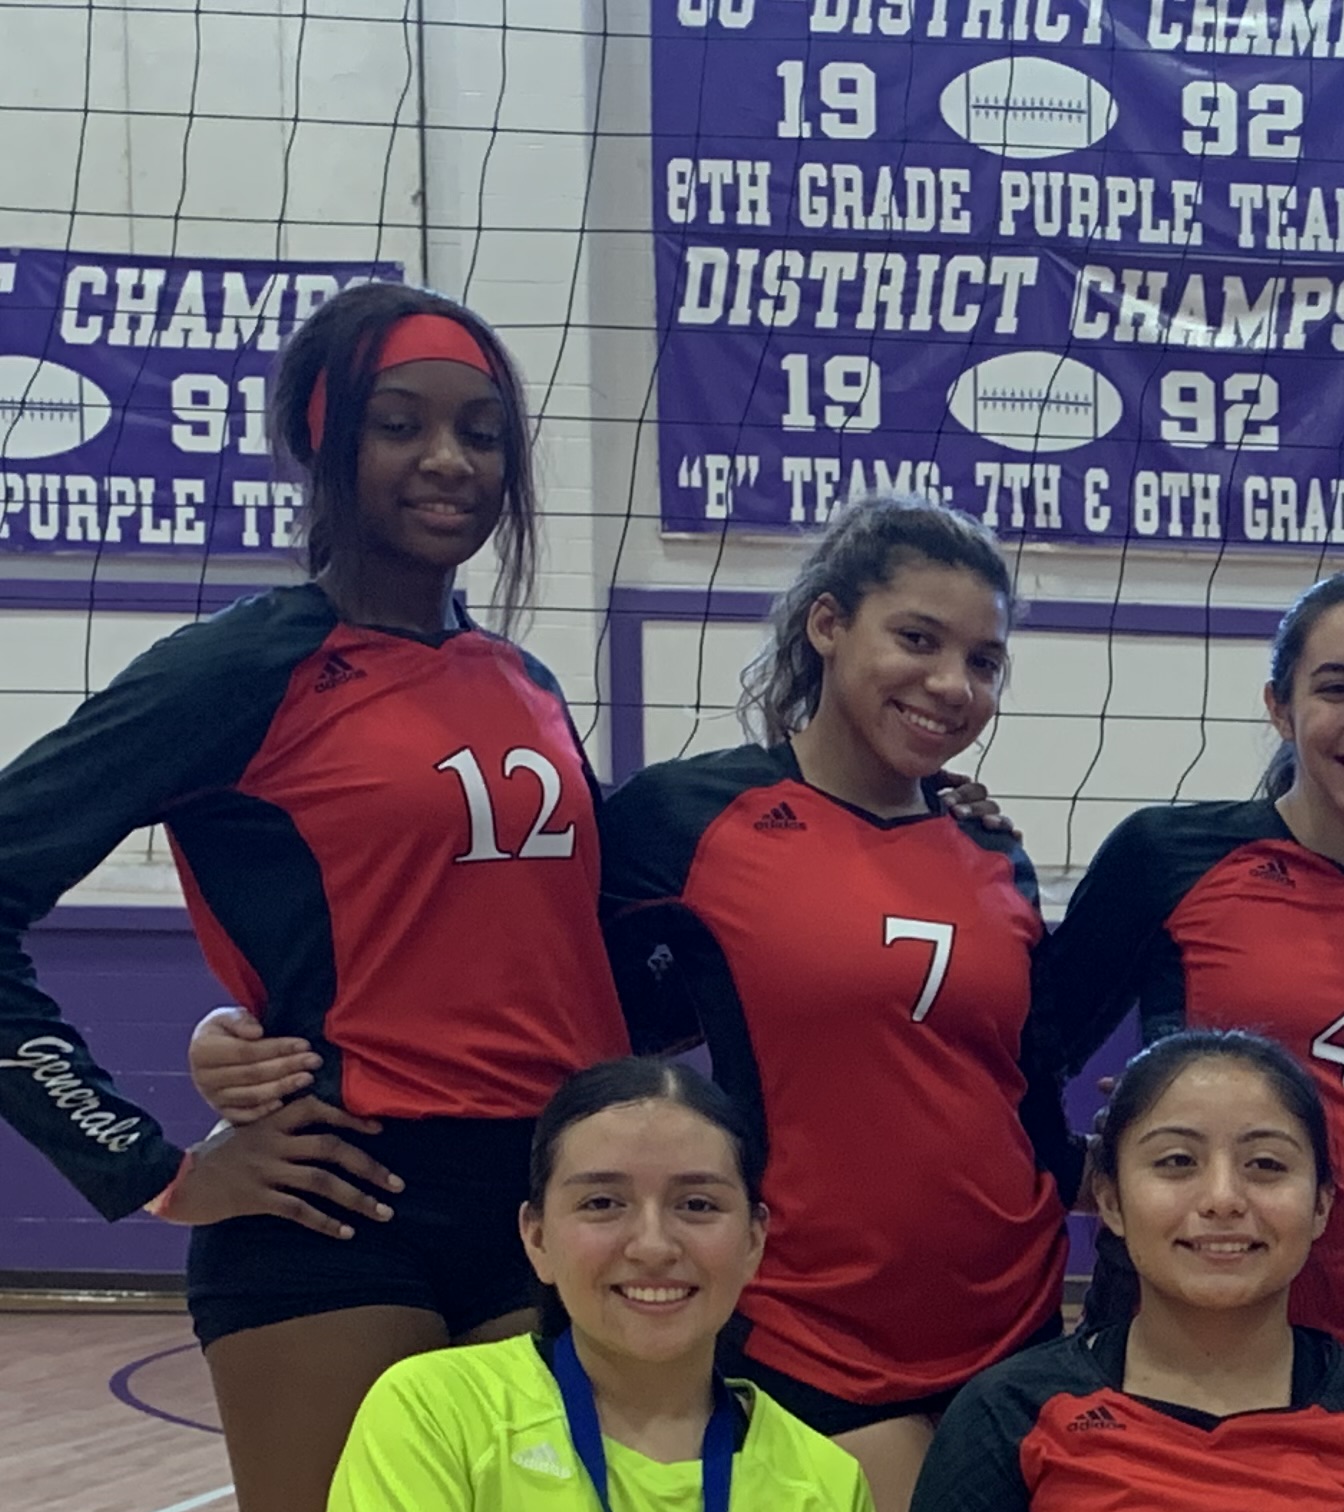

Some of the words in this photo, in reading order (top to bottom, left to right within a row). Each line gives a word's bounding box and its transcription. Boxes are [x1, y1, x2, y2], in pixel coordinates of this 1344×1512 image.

[776, 60, 877, 140] 19
[1180, 82, 1303, 159] 92
[666, 157, 771, 227] 8TH
[799, 162, 972, 235] GRADE
[1000, 170, 1203, 247] PURPLE
[60, 265, 384, 350] CHAMP
[677, 247, 1038, 334] DISTRICT
[170, 373, 269, 456] 91
[779, 353, 882, 432] 19
[1159, 370, 1281, 452] 92
[232, 480, 304, 548] TE
[976, 462, 1063, 530] 7TH
[1133, 471, 1222, 540] 8TH
[434, 745, 577, 866] 12
[881, 913, 957, 1024] 7
[0, 1035, 142, 1154] Generals
[1066, 1419, 1127, 1433] adidas
